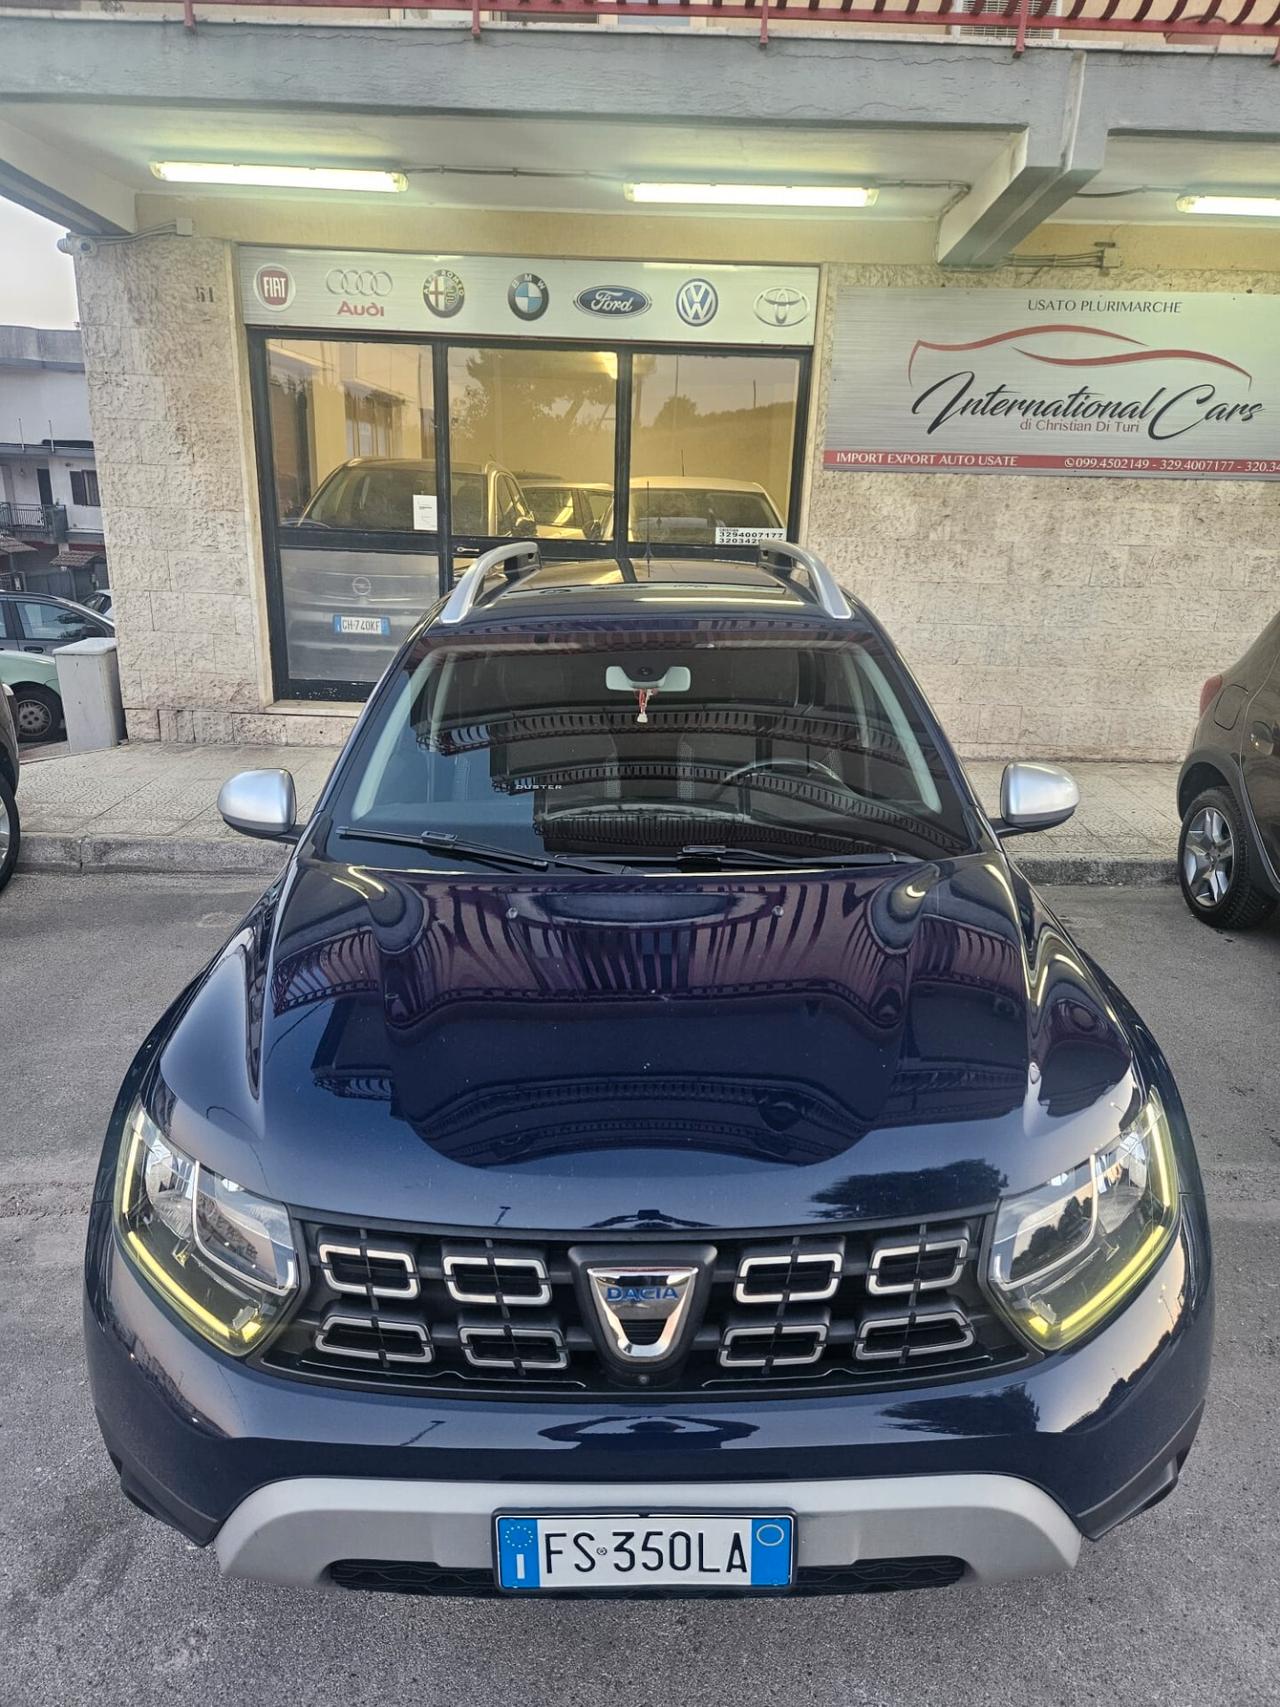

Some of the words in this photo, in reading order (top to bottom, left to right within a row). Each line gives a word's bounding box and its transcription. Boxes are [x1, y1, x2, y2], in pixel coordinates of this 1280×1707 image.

[263, 276, 288, 298] FIAT
[511, 274, 546, 290] BMW
[336, 301, 385, 317] Audi
[590, 289, 634, 313] Ford
[1028, 299, 1077, 312] USATO
[1081, 300, 1183, 314] PLURIMARCHE
[911, 370, 1166, 435] International
[1147, 383, 1265, 440] Cars
[1019, 418, 1032, 431] di
[1036, 419, 1092, 432] Christian
[1096, 420, 1110, 432] Di
[1115, 421, 1140, 433] Turi
[836, 452, 885, 464] IMPORT
[887, 453, 936, 465] EXPORT
[938, 454, 975, 466] AUTO
[978, 455, 1019, 467] USATE
[1075, 457, 1150, 470] 099.4502149
[1159, 459, 1235, 472] 329.4007177
[607, 1287, 679, 1300] DACIA
[544, 1532, 596, 1574] FS
[612, 1531, 748, 1573] 350LA
